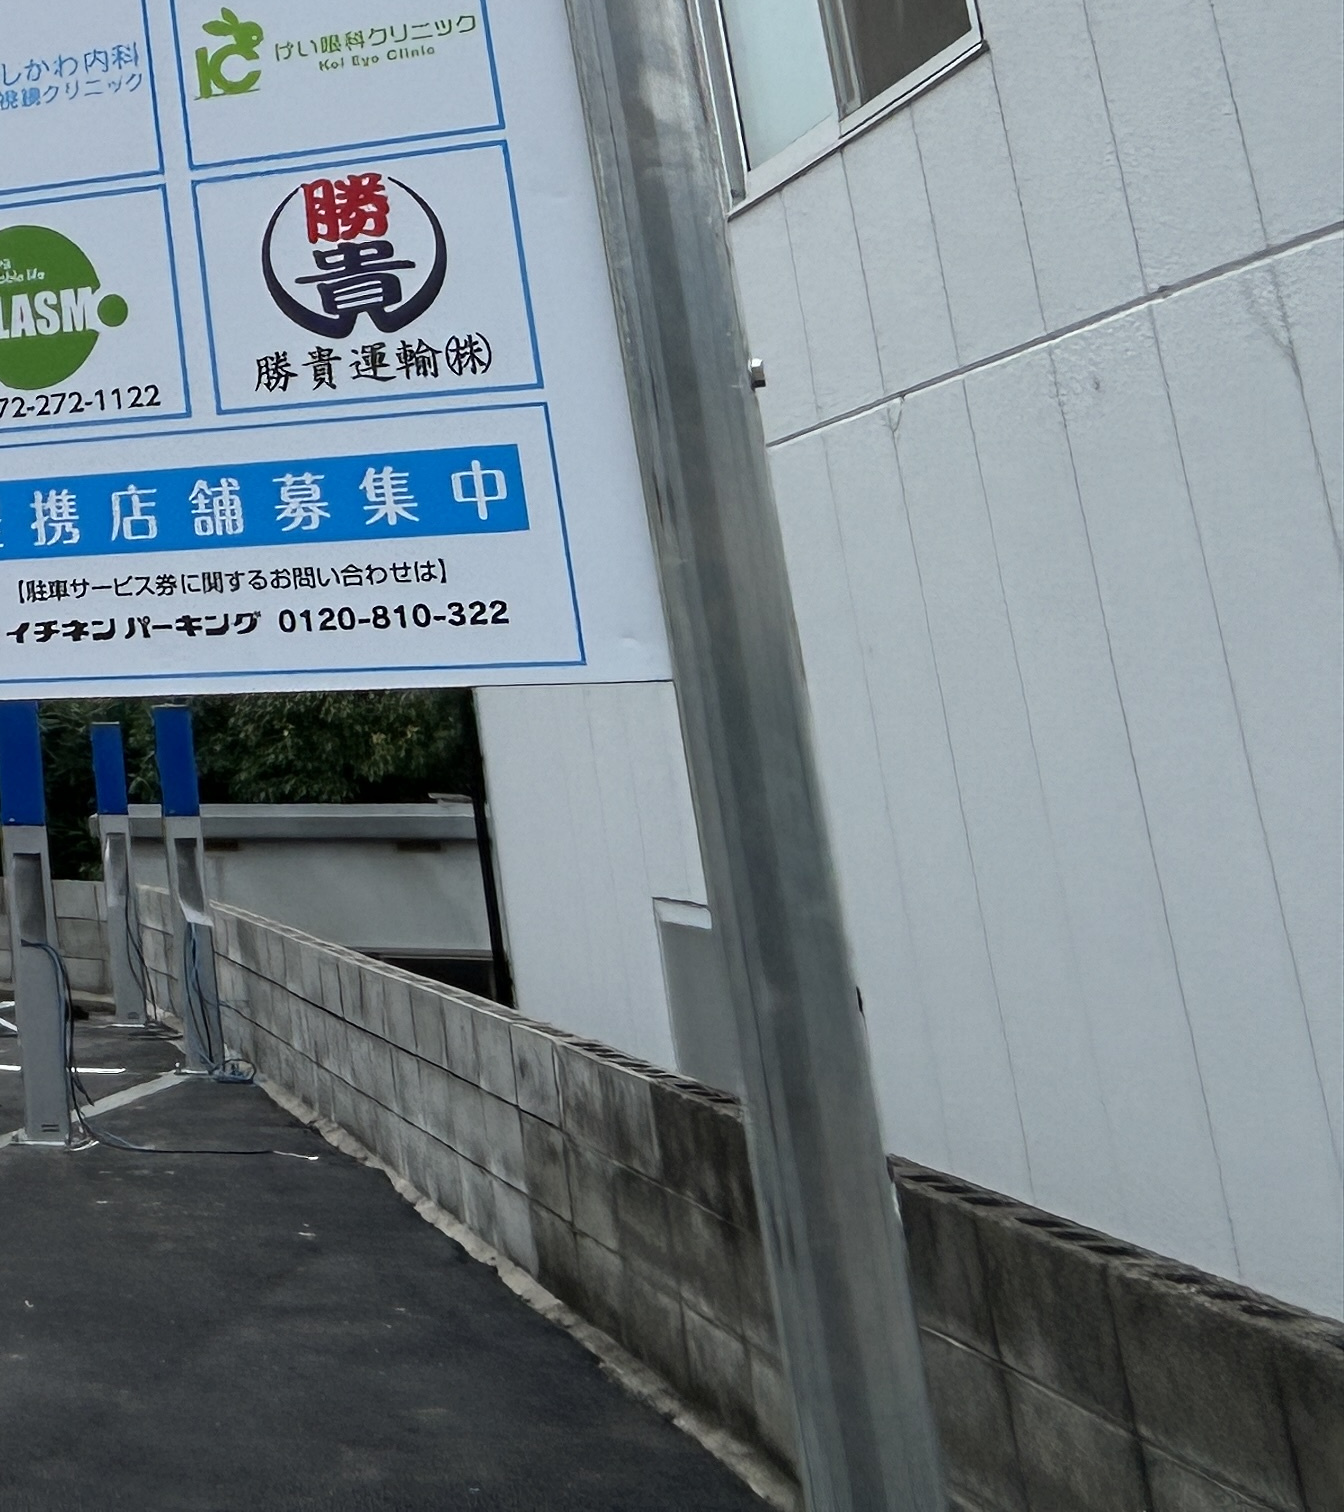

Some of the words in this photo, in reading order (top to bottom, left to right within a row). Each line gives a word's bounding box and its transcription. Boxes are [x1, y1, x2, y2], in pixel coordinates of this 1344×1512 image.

[275, 15, 476, 62] けい眼科クリニック
[18, 558, 448, 604] 【駐車サービス券に関するお問い合わせは】
[5, 617, 117, 644] イチネン
[124, 609, 262, 640] パーキング
[278, 599, 511, 634] 0120-810-322
